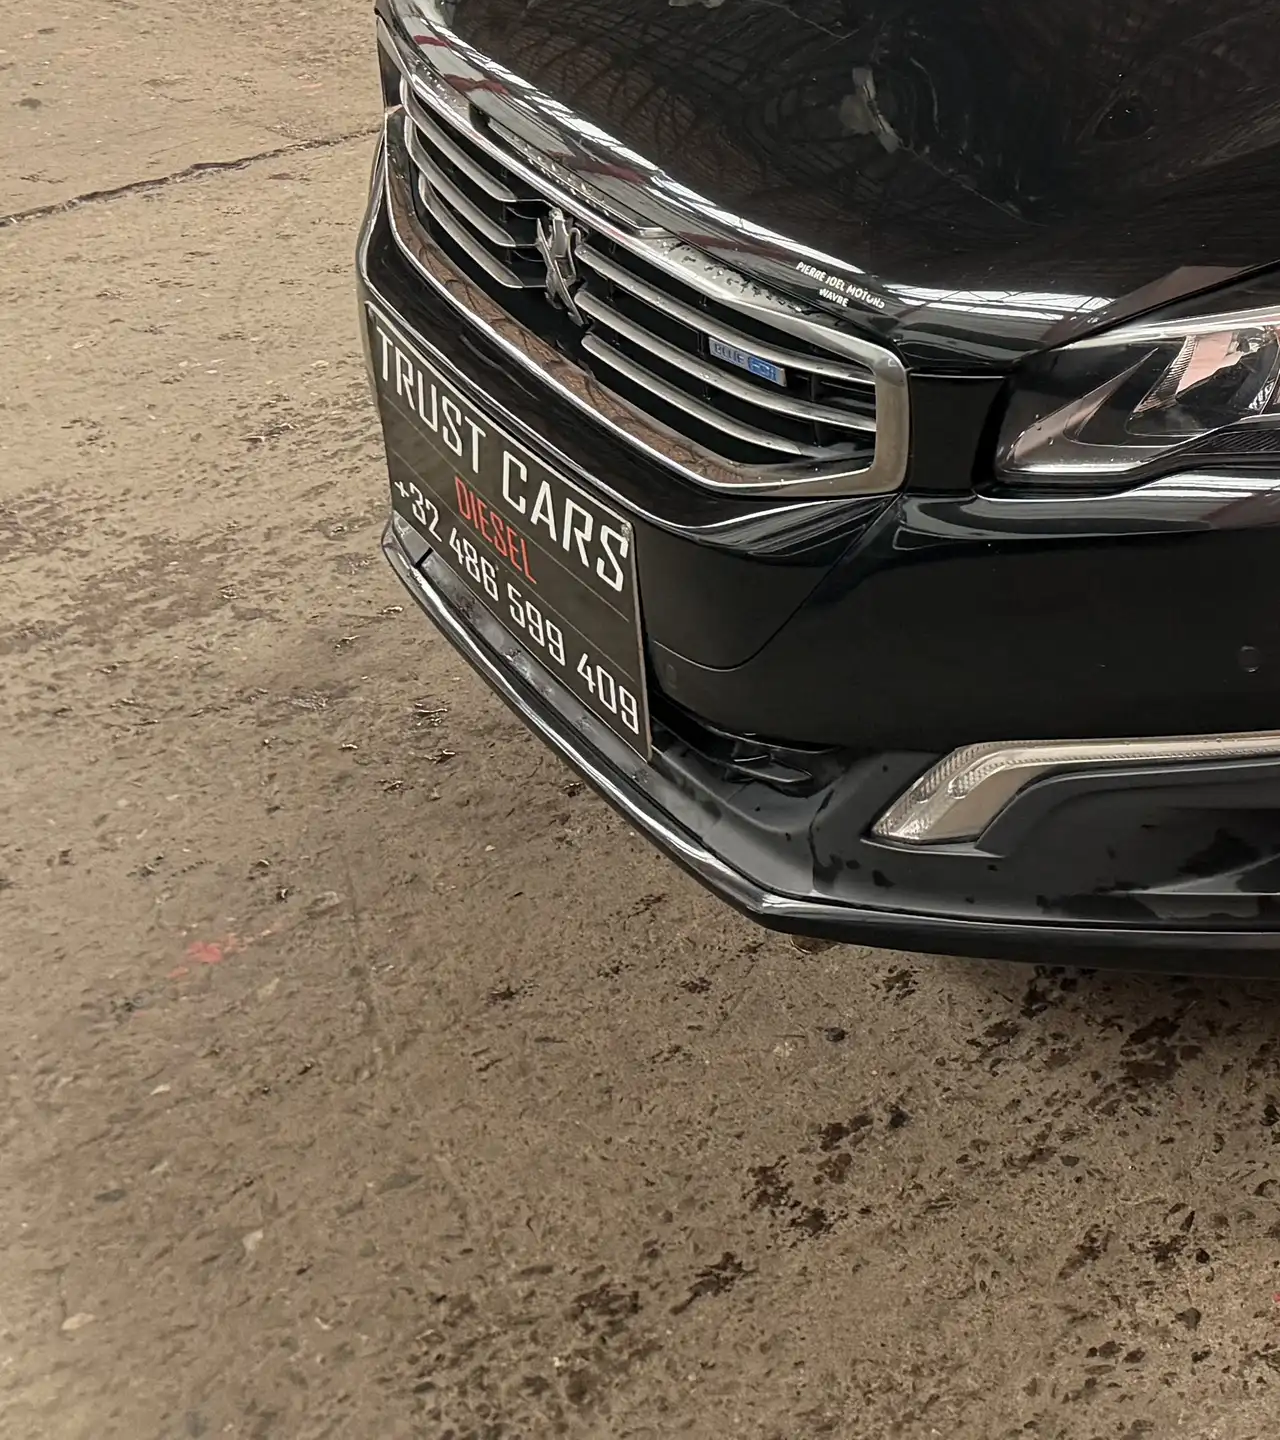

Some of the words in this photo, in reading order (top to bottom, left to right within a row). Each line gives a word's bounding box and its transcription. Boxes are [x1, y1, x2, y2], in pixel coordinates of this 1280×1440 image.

[795, 261, 827, 283] PIERRE
[826, 276, 846, 293] JOEL
[818, 288, 850, 308] WAVRE
[376, 324, 487, 474] TRUST
[501, 450, 631, 593] CARS
[454, 475, 537, 585] DIESEL
[393, 479, 443, 543] +32
[448, 526, 500, 602] 486
[507, 582, 566, 668] 599
[577, 652, 640, 736] 409
